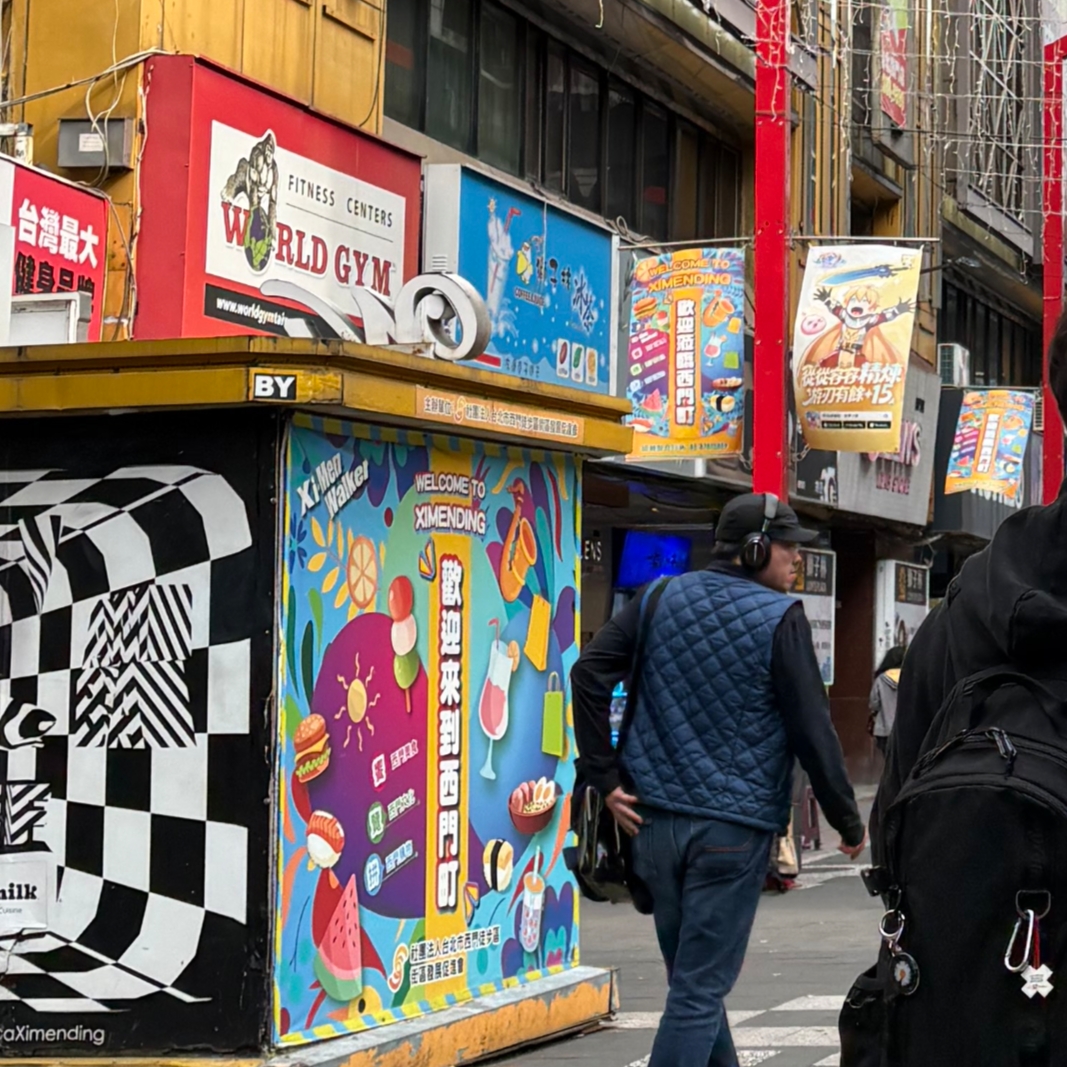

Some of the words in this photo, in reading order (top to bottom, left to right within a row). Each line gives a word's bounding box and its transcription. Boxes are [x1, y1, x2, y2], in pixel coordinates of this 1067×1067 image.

[288, 174, 335, 207] FITNESS
[346, 197, 393, 228] CENTERS
[18, 198, 100, 269] 台灣最大
[334, 244, 393, 297] GYM
[649, 260, 708, 276] WELCOME
[712, 259, 730, 270] TO
[649, 273, 731, 293] XIMENDING
[255, 374, 295, 398] BY
[324, 459, 369, 520] Walker
[415, 473, 469, 494] WELCOME
[471, 479, 486, 498] TO
[415, 506, 486, 534] XIMENDING
[437, 559, 462, 909] 歡迎來到西門町
